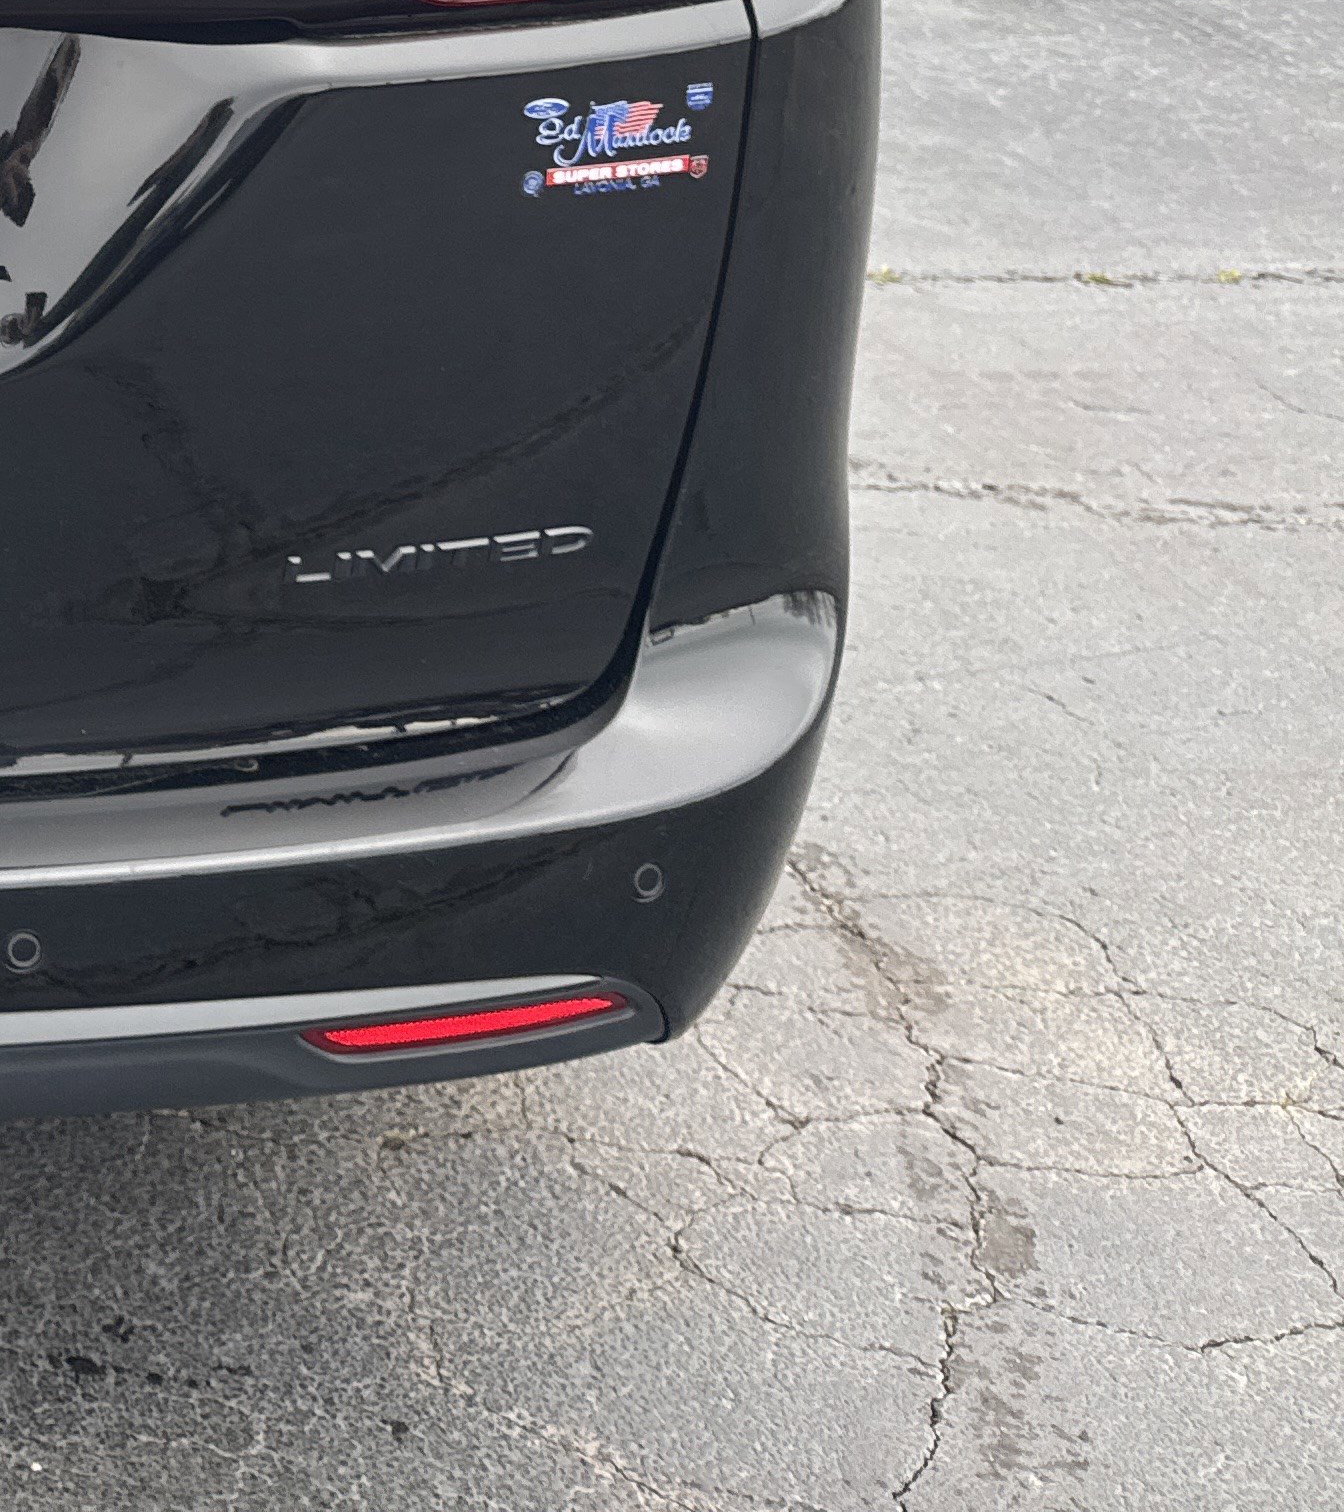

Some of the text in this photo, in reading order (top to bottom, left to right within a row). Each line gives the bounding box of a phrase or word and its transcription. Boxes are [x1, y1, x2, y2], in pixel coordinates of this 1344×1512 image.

[536, 116, 583, 146] Ed
[552, 158, 684, 184] SUPER STORES
[286, 526, 593, 583] LIMITED
